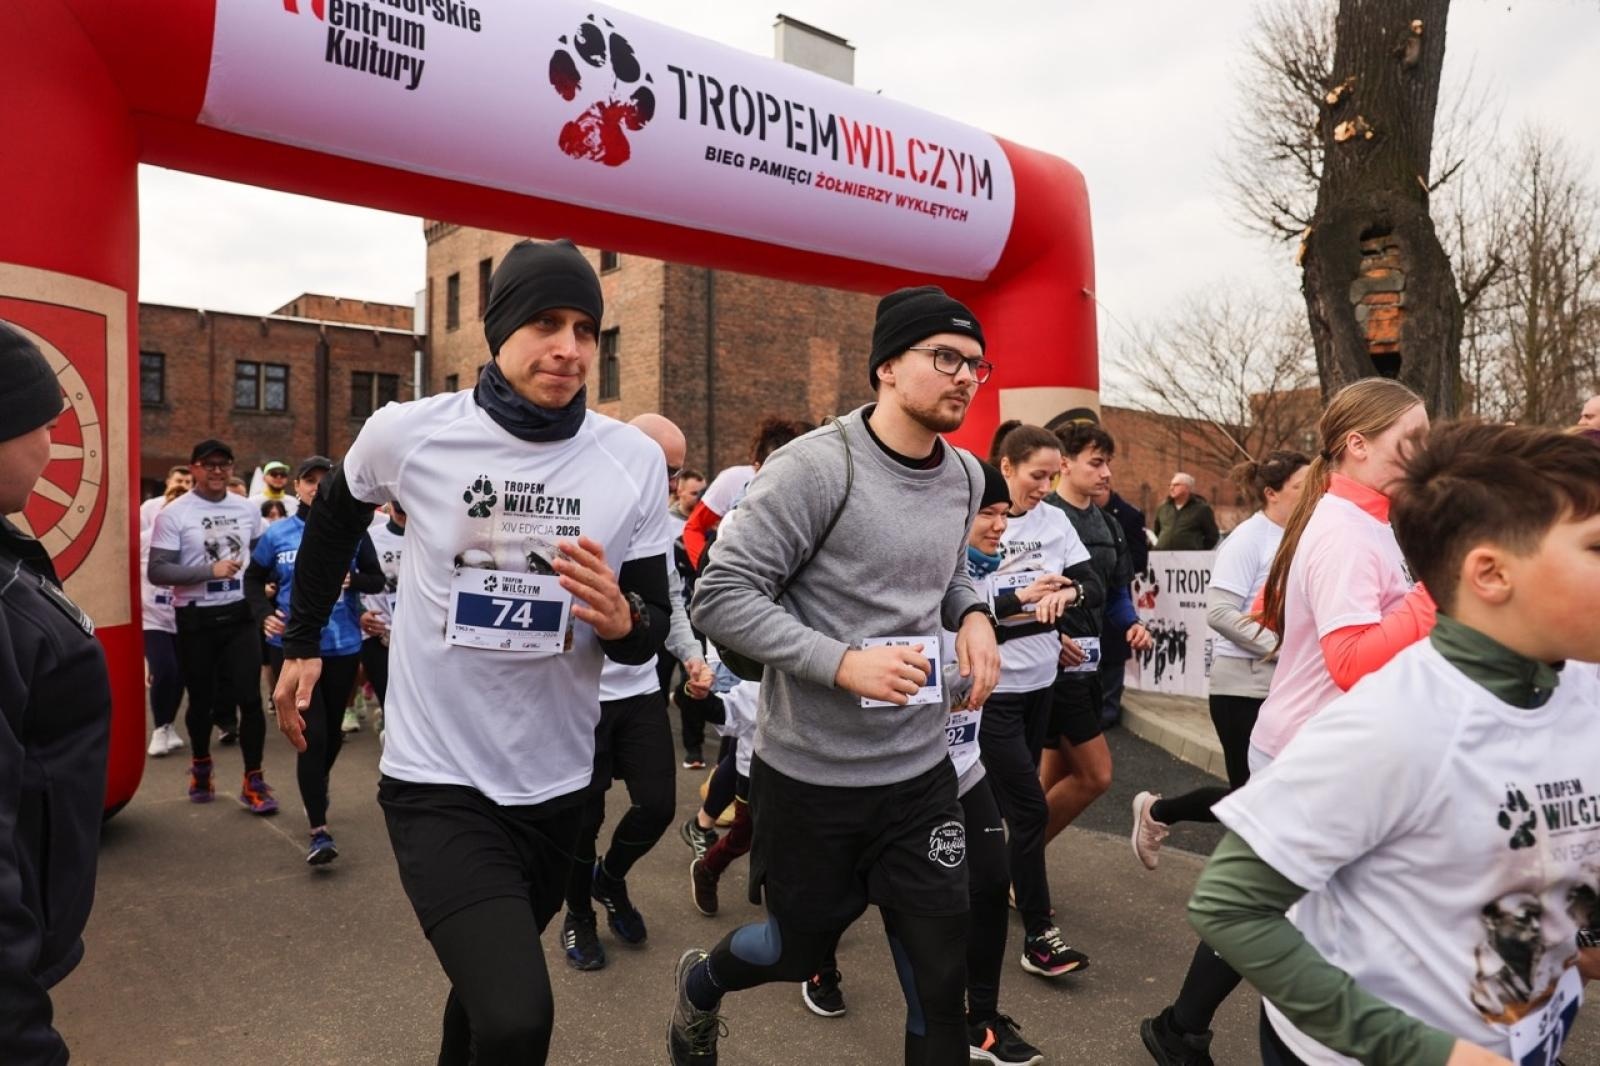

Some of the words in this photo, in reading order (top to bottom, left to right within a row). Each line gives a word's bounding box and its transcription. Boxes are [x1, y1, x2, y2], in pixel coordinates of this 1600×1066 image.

[325, 26, 425, 90] Kultury
[705, 145, 745, 168] BIEG
[749, 156, 812, 185] PAMIĘCI
[815, 171, 893, 204] ŻOŁNIERZY
[895, 193, 968, 222] WYKLĘTYCH
[504, 480, 545, 494] TROPEM
[504, 494, 581, 516] WILCZYM
[500, 521, 517, 533] XIV
[519, 523, 554, 536] EDYCJA
[556, 525, 580, 537] 2026
[502, 584, 540, 595] WILCZYM
[491, 598, 533, 629] 74
[1536, 779, 1583, 800] TROPEM
